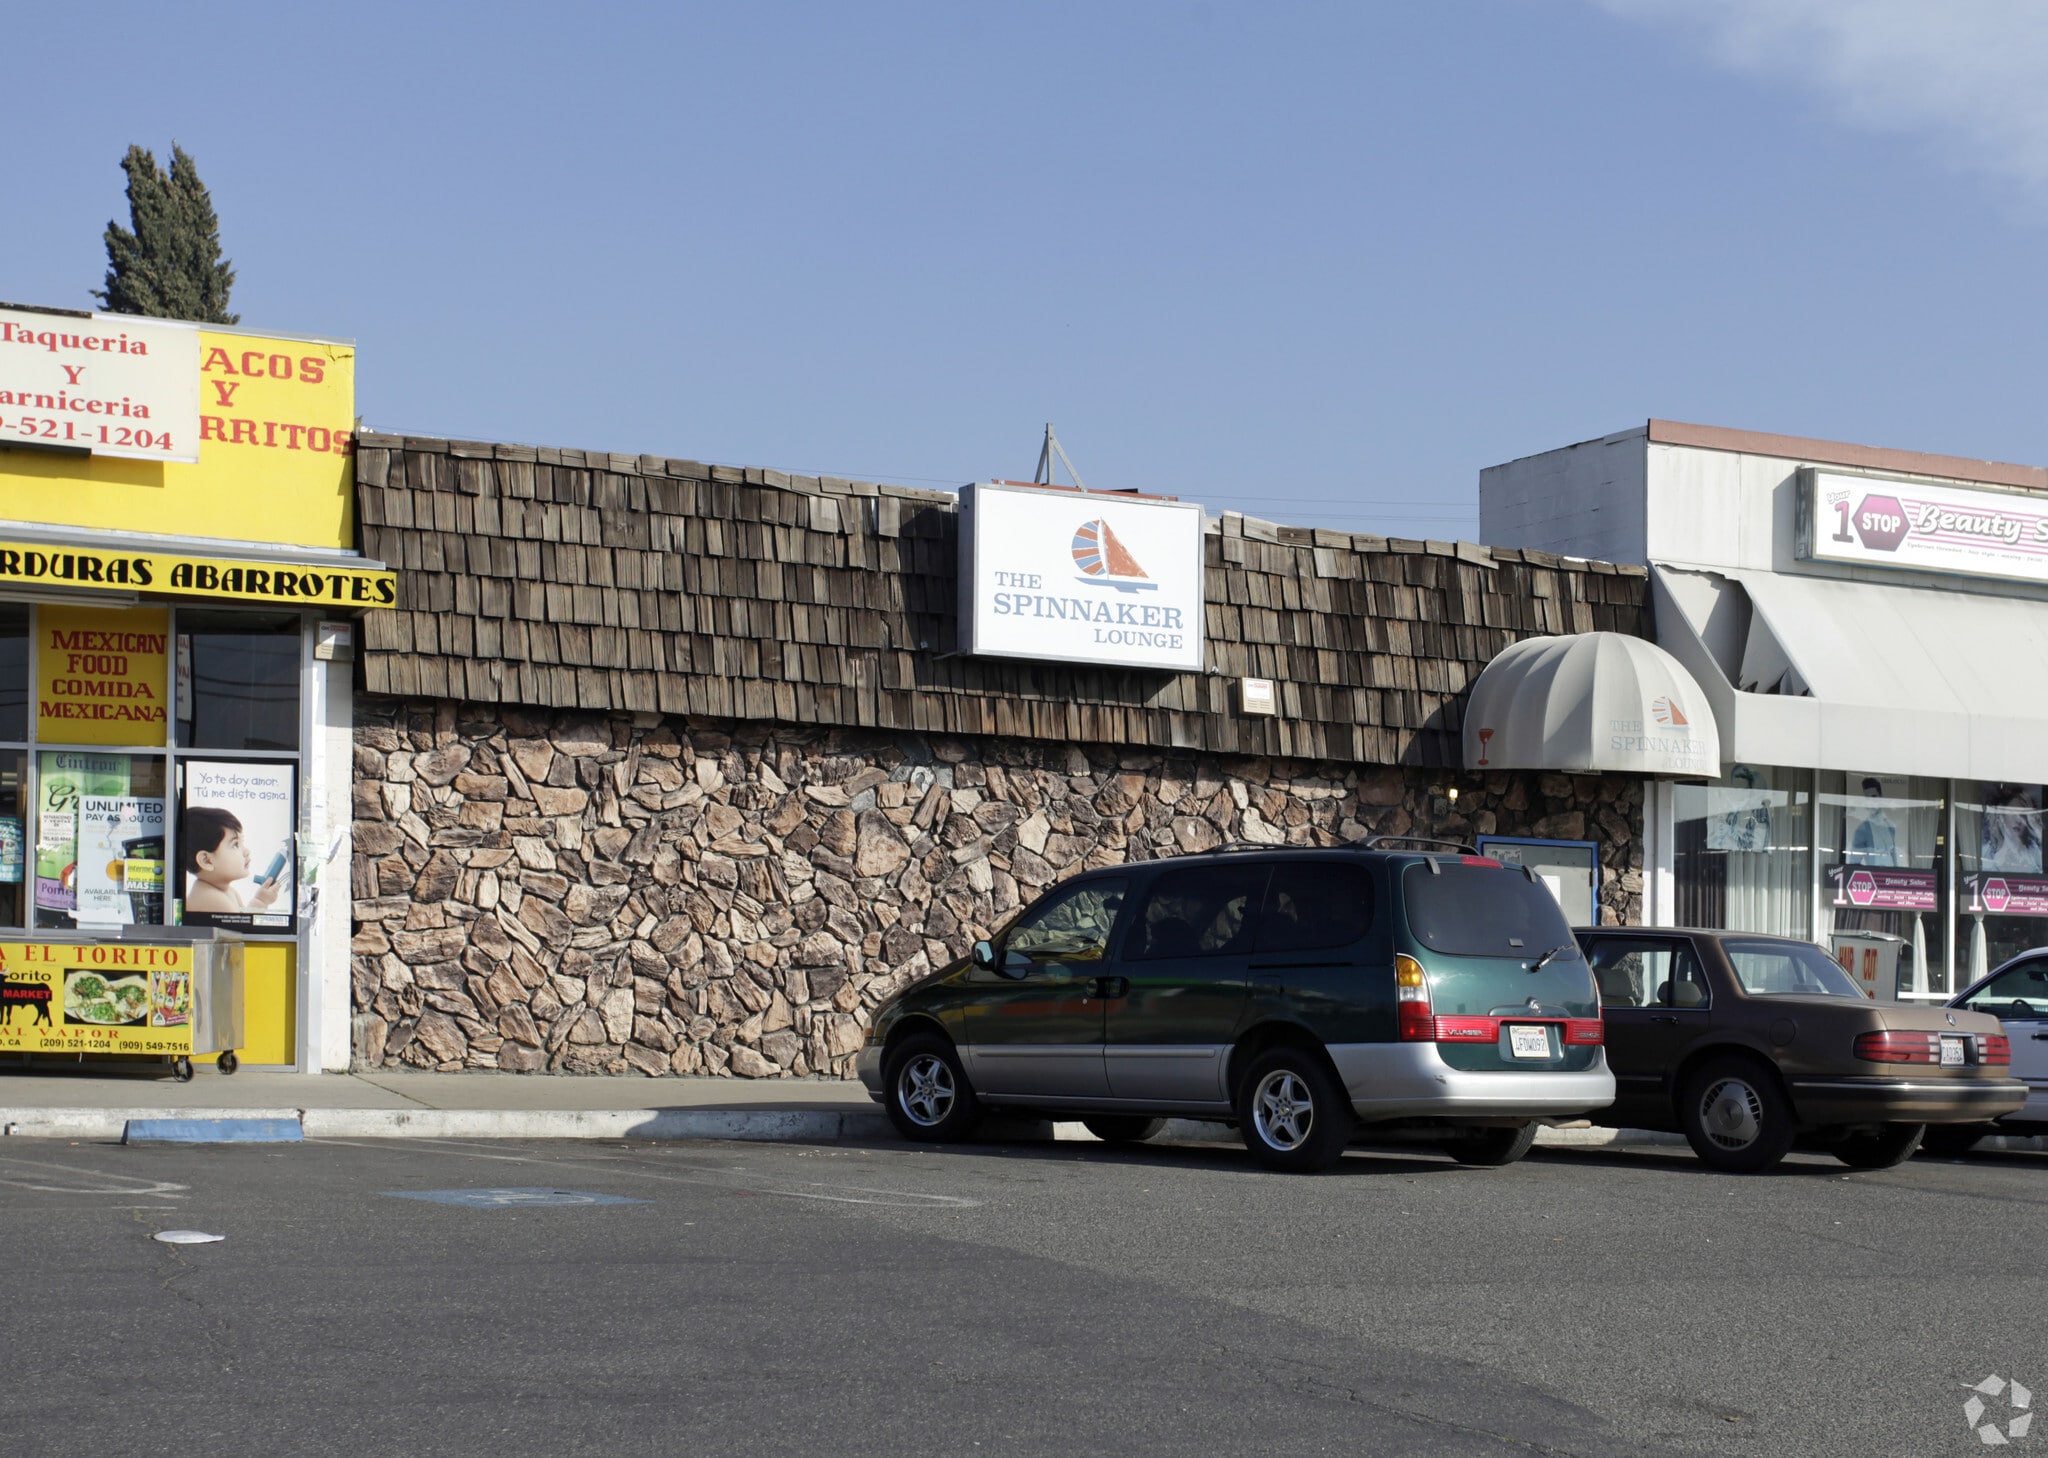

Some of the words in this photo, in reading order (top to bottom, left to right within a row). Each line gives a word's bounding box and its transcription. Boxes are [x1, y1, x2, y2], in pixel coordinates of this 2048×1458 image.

[0, 321, 148, 355] Taqueria
[61, 364, 86, 386] Y
[200, 346, 326, 384] ACOS
[211, 379, 240, 407] Y
[0, 415, 173, 451] -521-1204
[1832, 500, 1855, 543] 1
[1862, 512, 1901, 533] STOP
[1916, 502, 2023, 546] Beauty
[0, 549, 153, 586] RDURAS
[171, 563, 395, 604] ABARROTES
[994, 571, 1042, 590] THE
[993, 592, 1184, 630] SPINNAKER
[51, 630, 166, 655] MEXICAN
[1094, 628, 1183, 650] LOUNGE
[67, 653, 128, 676] FOOD
[52, 679, 155, 699] COMIDA
[40, 701, 167, 723] MEXICANA
[1609, 720, 1642, 732] THE
[199, 772, 213, 784] Yo
[215, 774, 226, 784] te
[228, 774, 250, 786] doy
[194, 786, 208, 797] Tú
[211, 790, 225, 798] me
[228, 788, 257, 799] diste
[107, 814, 120, 822] AS
[147, 816, 163, 824] GO
[1833, 872, 1848, 904] 1
[1852, 881, 1872, 892] STOP
[1968, 880, 1982, 911] 1
[1986, 888, 2006, 899] STOP
[24, 945, 56, 962] EL
[73, 946, 178, 966] TORITO
[1863, 948, 1878, 981] CUT
[4, 970, 52, 981] orito
[3, 990, 51, 999] MARKET
[39, 1028, 119, 1039] VAPOR
[40, 1039, 64, 1048] (209)
[67, 1039, 111, 1049] 521-1204
[119, 1041, 143, 1051] (909)
[146, 1041, 189, 1051] 549-7516
